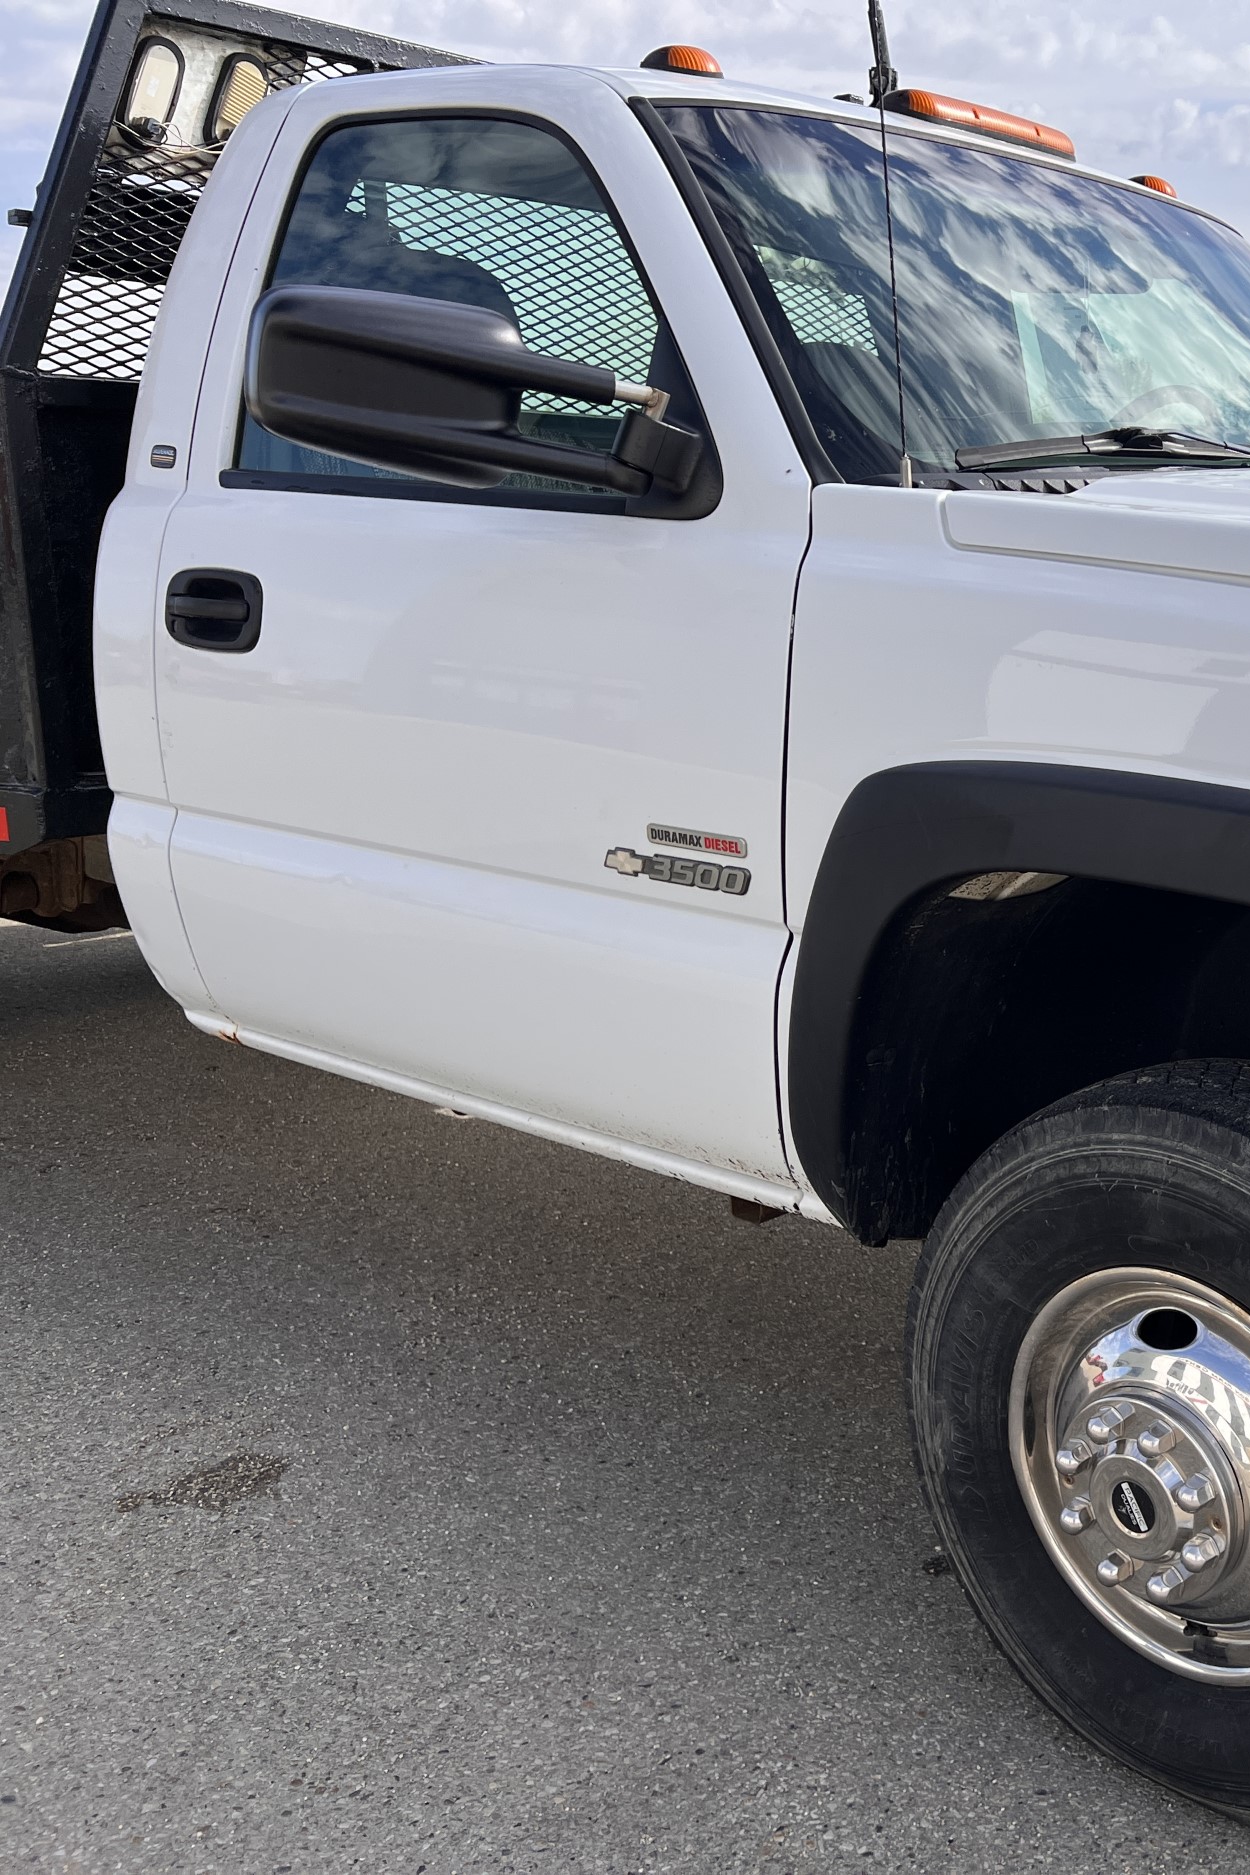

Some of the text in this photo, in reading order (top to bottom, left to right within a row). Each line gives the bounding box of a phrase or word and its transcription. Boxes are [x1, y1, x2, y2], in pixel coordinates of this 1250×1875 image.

[650, 828, 742, 854] DURAMAX DIESEL
[650, 854, 750, 895] 3500
[1124, 1486, 1146, 1528] PACIFIC
